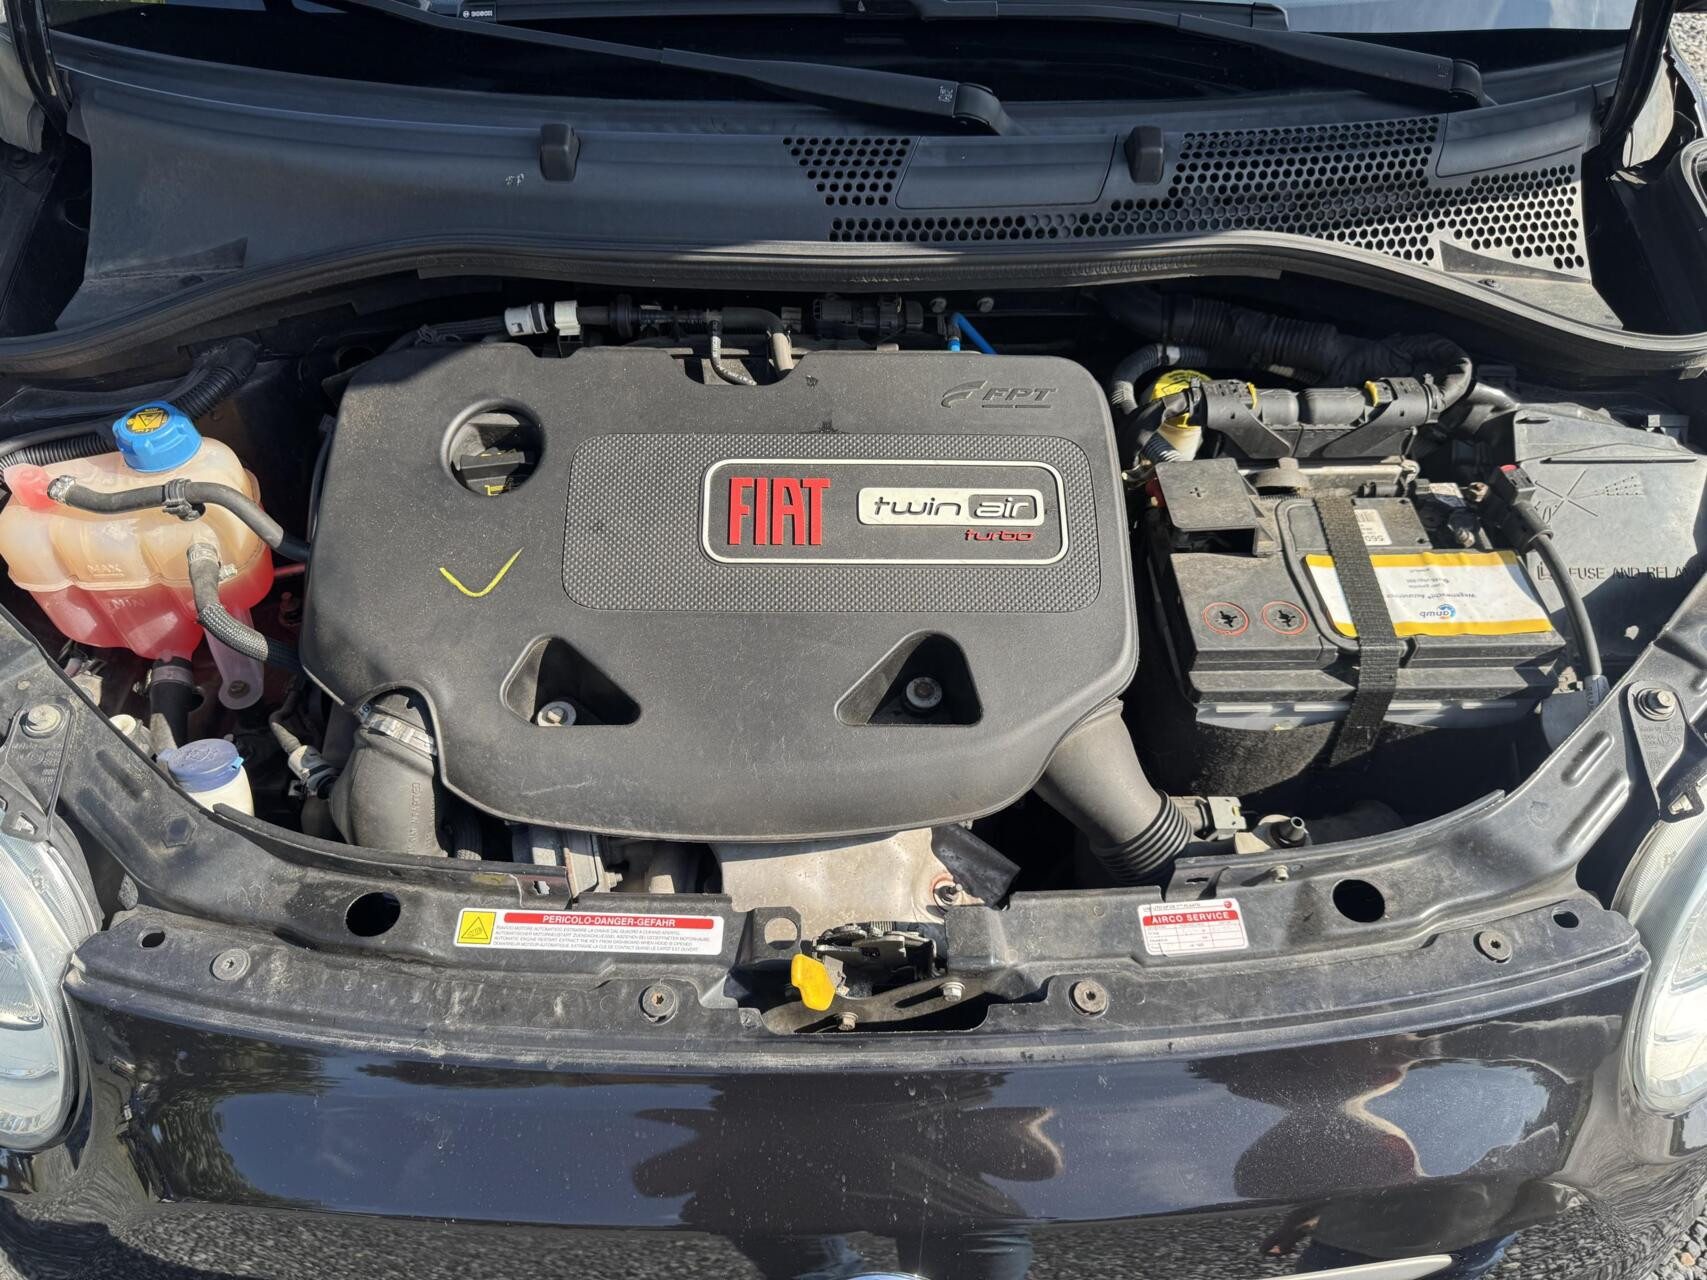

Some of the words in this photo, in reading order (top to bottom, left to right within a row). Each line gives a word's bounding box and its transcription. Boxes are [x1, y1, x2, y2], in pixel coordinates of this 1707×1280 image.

[982, 388, 1058, 400] FPT
[728, 477, 831, 546] FIAT
[874, 496, 961, 516] twin
[974, 496, 1029, 518] air
[964, 528, 1035, 542] turbo
[1568, 568, 1606, 580] FUSE
[1419, 610, 1449, 618] anwb
[542, 915, 676, 927] PERICOLO-DANGER-GEFAHR
[1152, 915, 1183, 924] AIRCO
[1186, 912, 1230, 922] SERVICE
